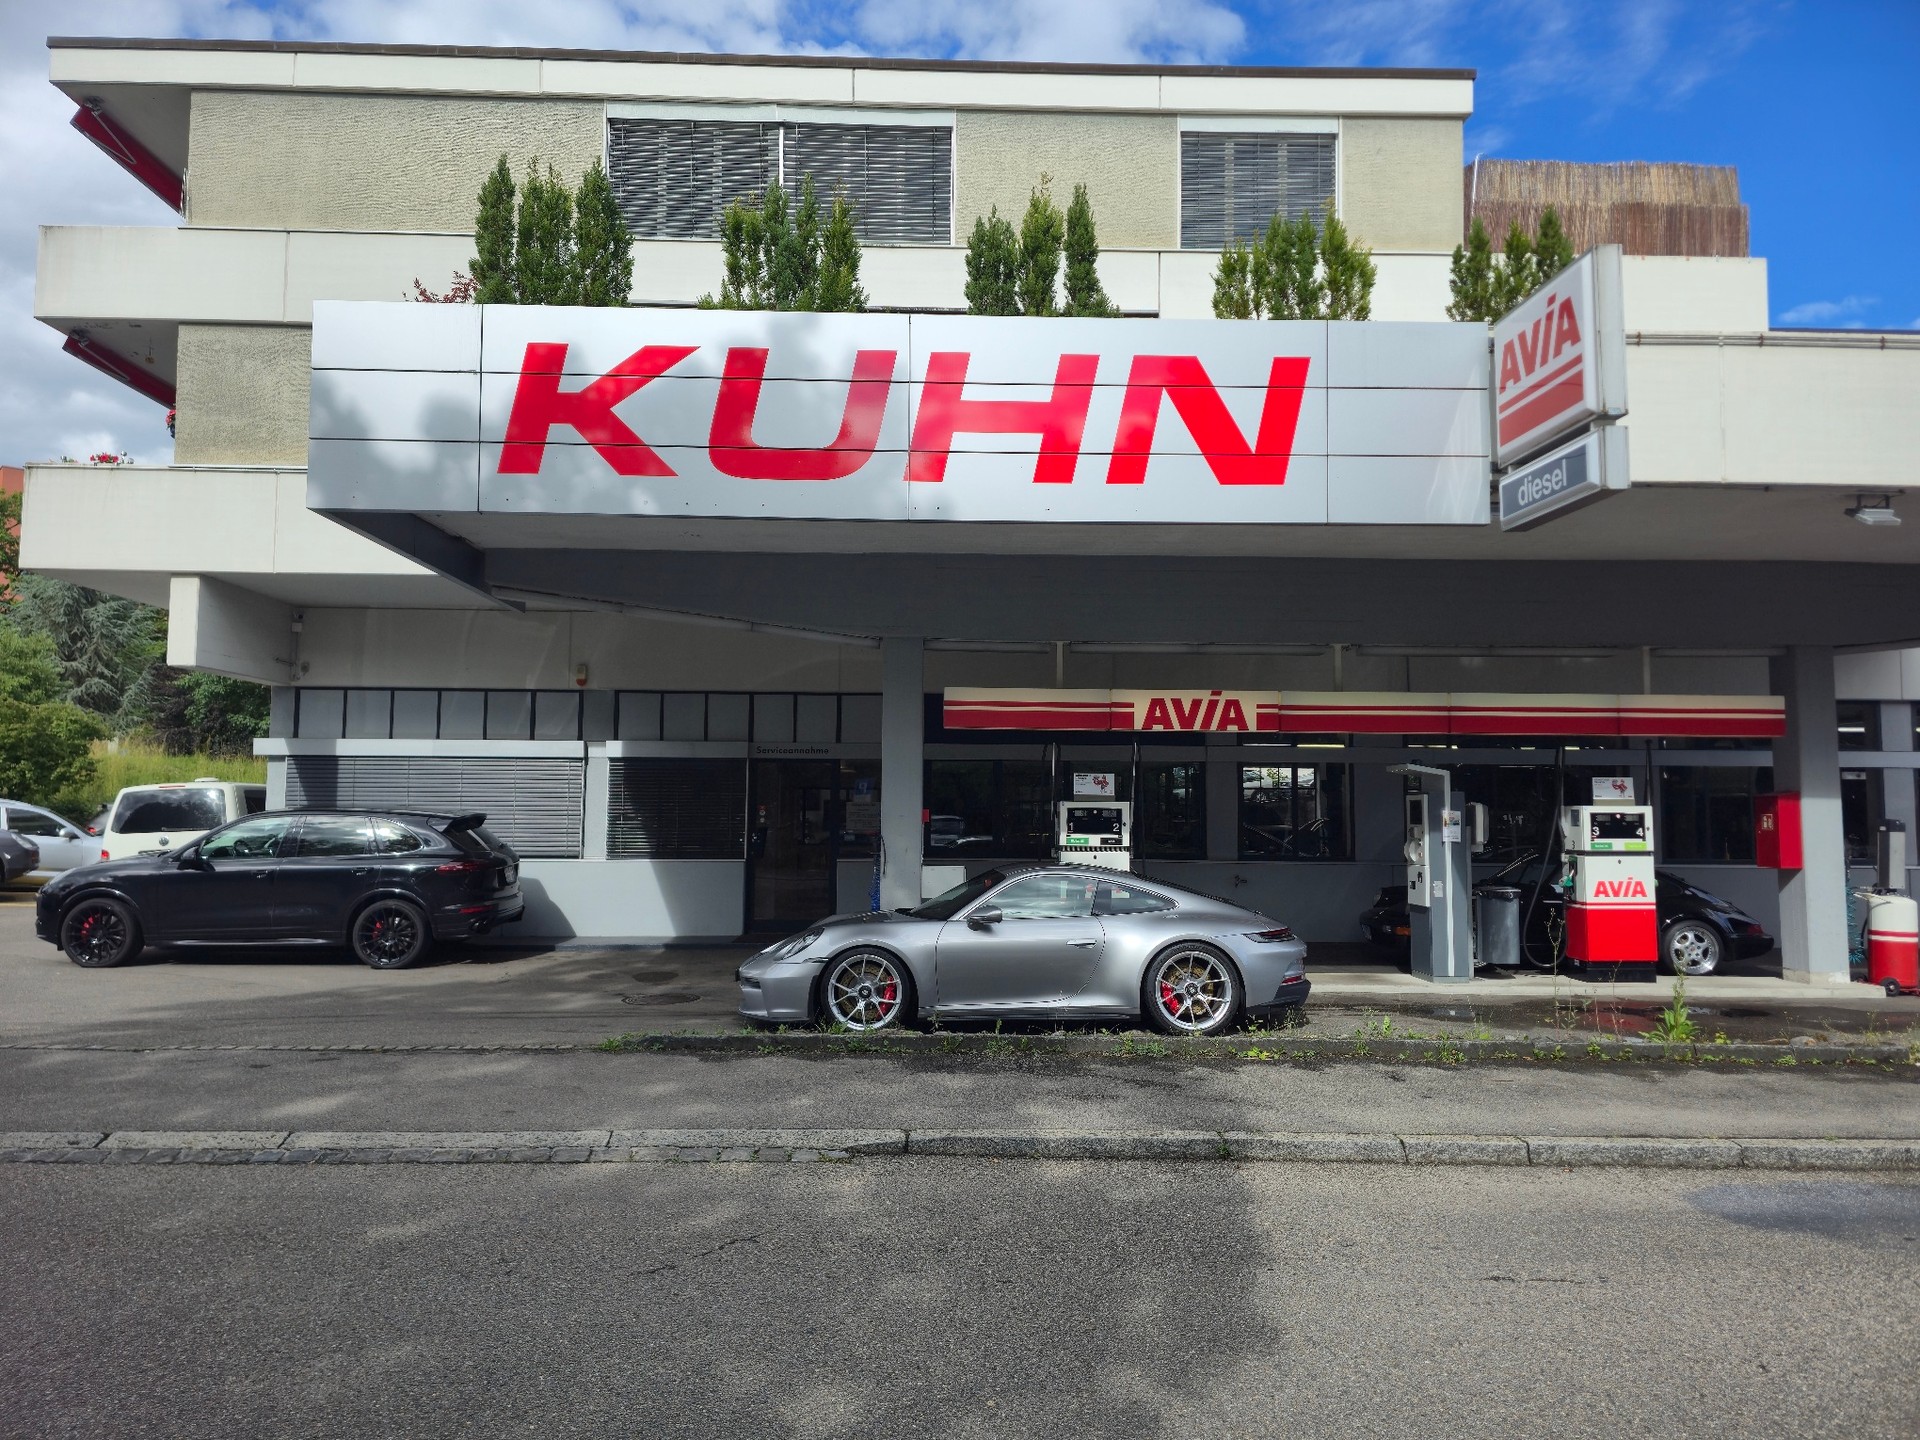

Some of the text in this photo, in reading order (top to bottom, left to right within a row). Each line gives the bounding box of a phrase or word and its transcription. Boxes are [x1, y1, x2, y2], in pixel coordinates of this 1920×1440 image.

[497, 342, 1312, 486] KUHN
[1518, 459, 1567, 506] diesel
[756, 746, 830, 755] Serviceannahme
[1068, 822, 1074, 831] 1
[1112, 822, 1120, 832] 2
[1592, 826, 1600, 836] 3
[1636, 828, 1644, 837] 4
